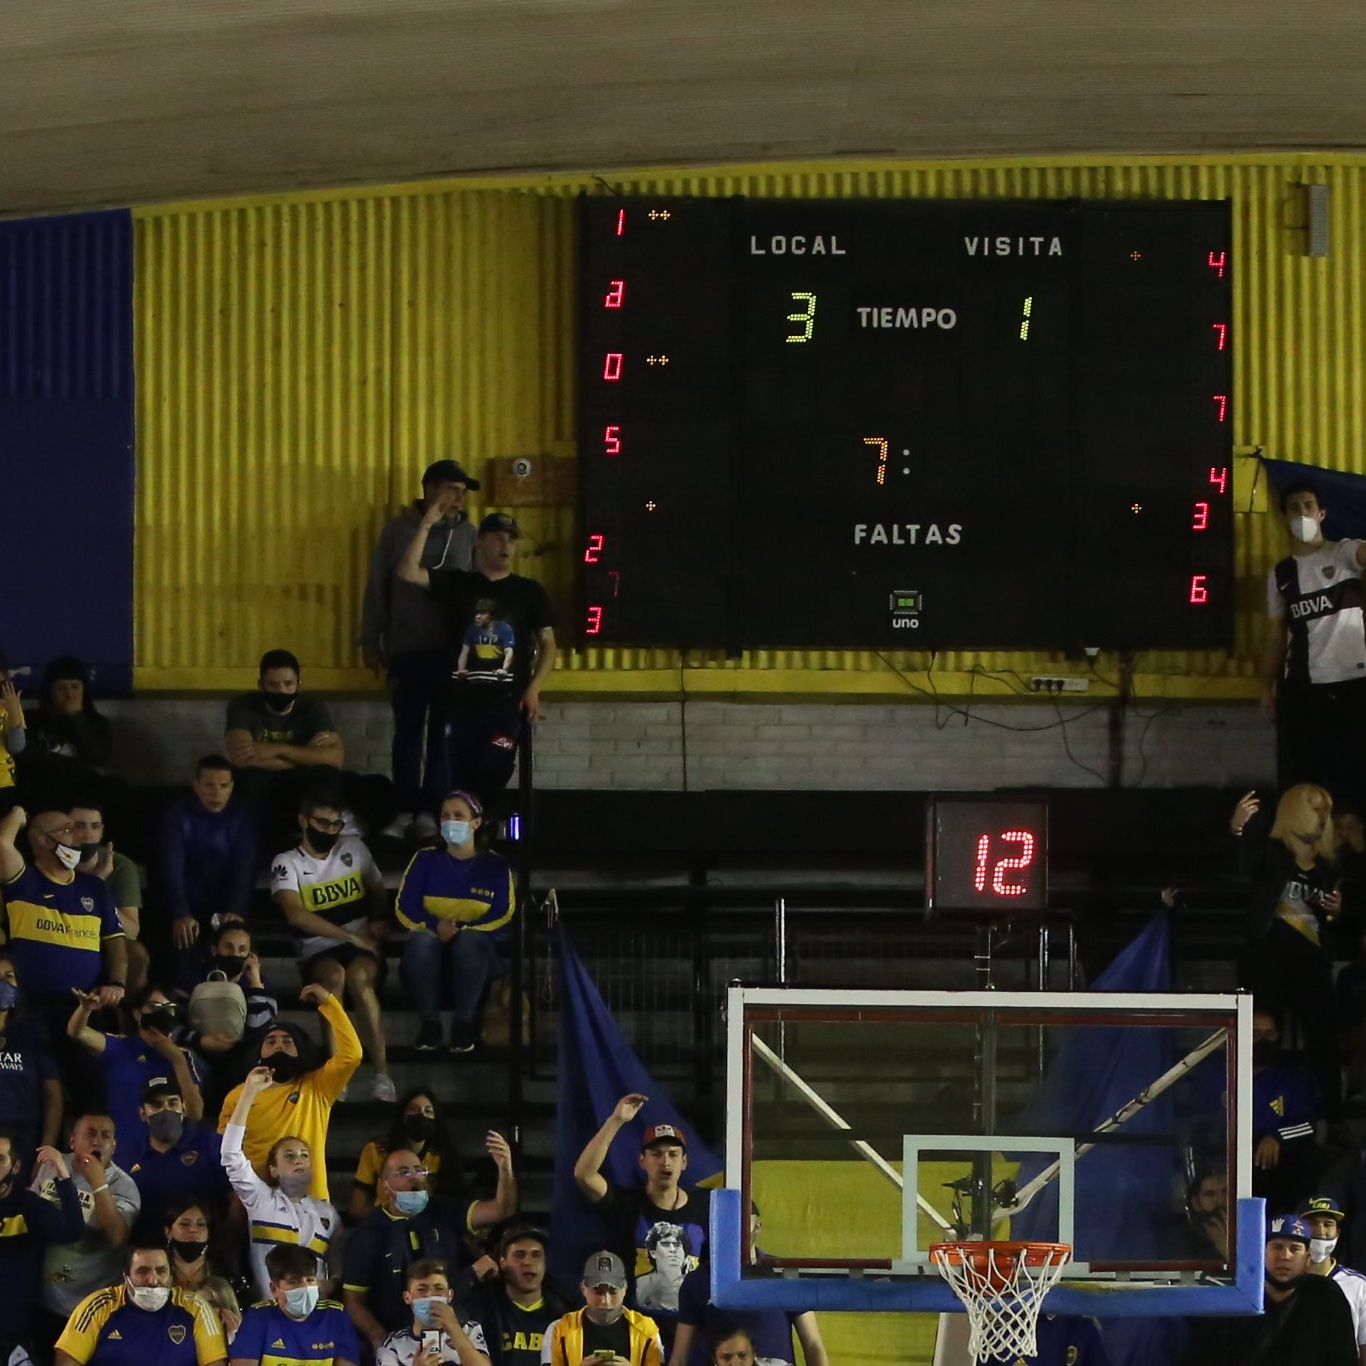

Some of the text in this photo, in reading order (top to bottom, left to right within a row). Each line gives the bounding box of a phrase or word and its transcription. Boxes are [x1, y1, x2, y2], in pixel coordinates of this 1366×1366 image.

[750, 235, 846, 256] LOCAL
[964, 236, 1063, 258] VISITA
[786, 292, 817, 343] 3
[857, 307, 957, 330] TIEMPO
[1019, 296, 1033, 341] 1
[1213, 324, 1227, 350] 7
[604, 353, 624, 380] 0
[1213, 395, 1227, 422] 7
[605, 426, 621, 454] 5
[1210, 467, 1227, 494] 4
[1192, 502, 1209, 530] 3
[854, 524, 963, 545] FALTAS
[585, 535, 603, 563] 2
[1191, 575, 1208, 603] 6
[586, 605, 602, 634] 3
[1291, 595, 1334, 619] BBVA
[892, 617, 920, 629] uno
[974, 830, 1034, 895] 12
[311, 876, 361, 906] BBVA
[501, 1331, 544, 1352] CAB
